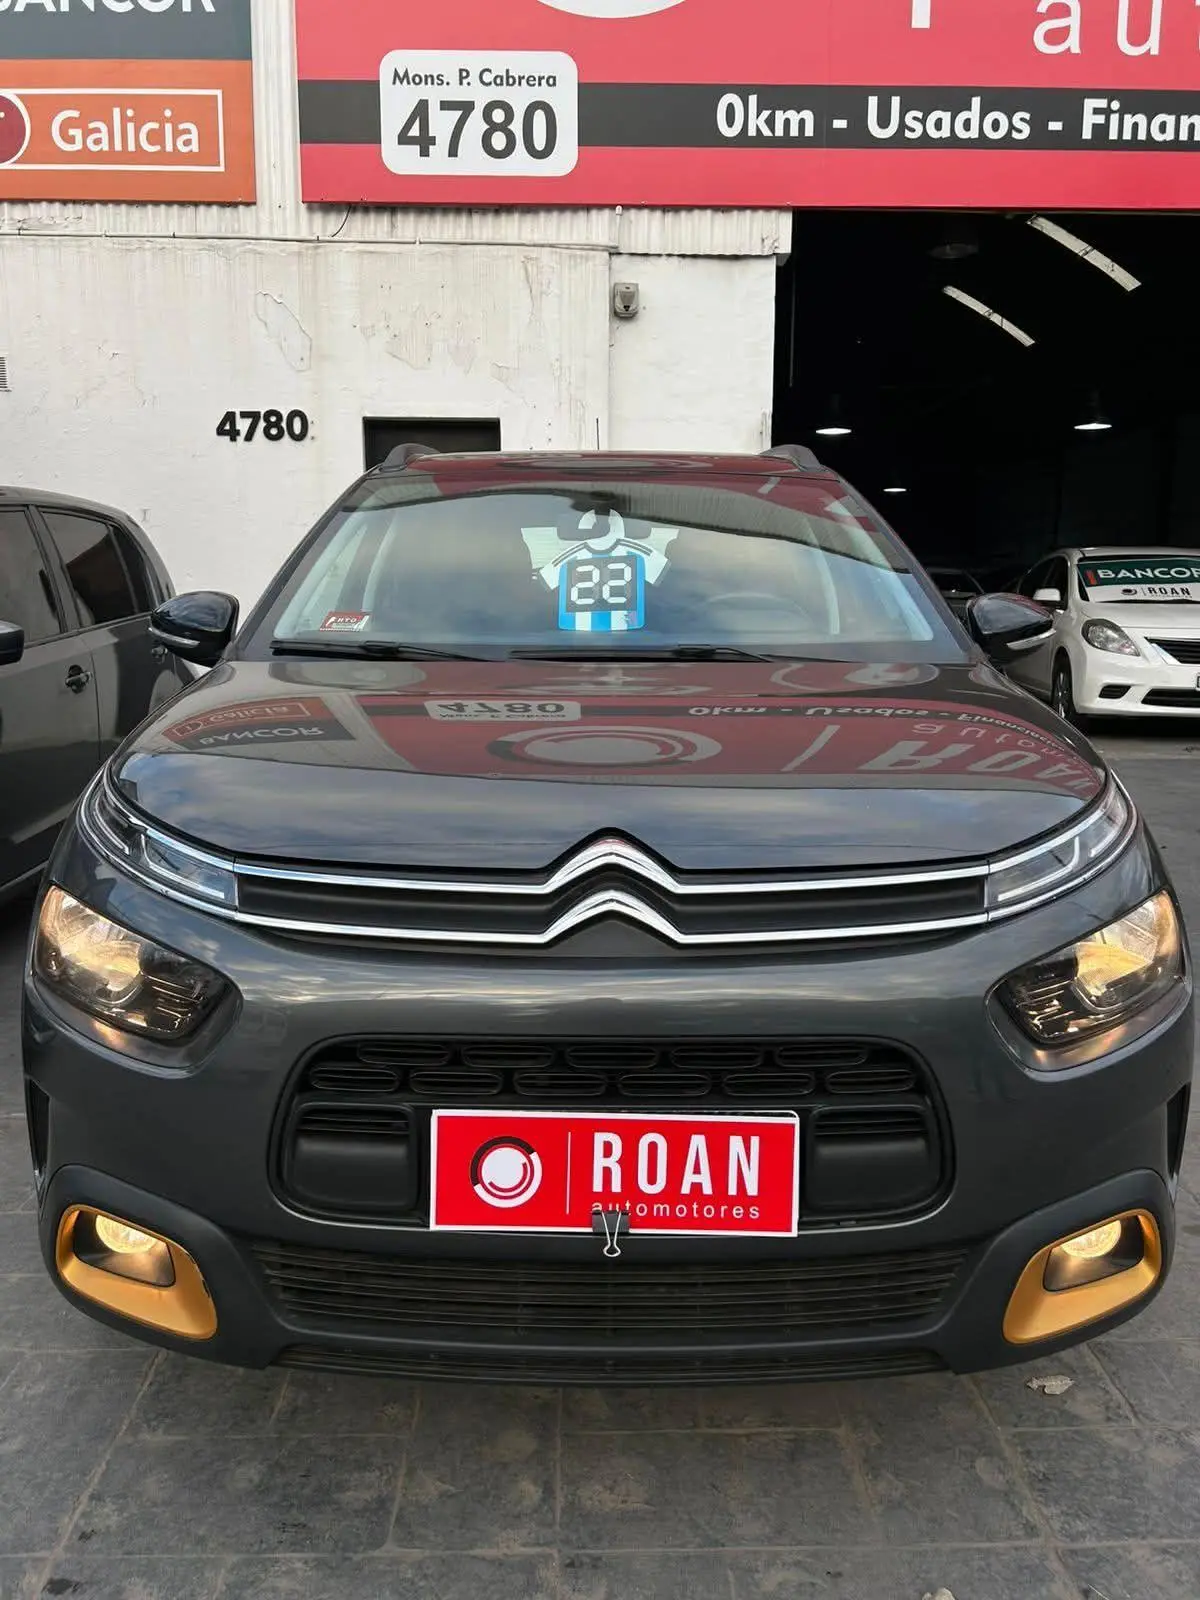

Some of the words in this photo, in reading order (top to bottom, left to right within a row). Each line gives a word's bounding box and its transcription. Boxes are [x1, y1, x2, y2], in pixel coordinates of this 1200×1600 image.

[1033, 0, 1200, 56] au
[392, 68, 450, 86] Mons.
[458, 68, 471, 86] P.
[479, 68, 557, 87] Cabrera
[51, 107, 200, 153] Galicia
[397, 98, 558, 160] 4780
[716, 93, 814, 138] 0km
[867, 95, 1031, 139] Usados
[1082, 98, 1200, 142] Finan
[216, 408, 309, 442] 4780
[570, 562, 632, 605] 22
[1147, 586, 1191, 596] ROAN
[592, 1131, 760, 1197] ROAN
